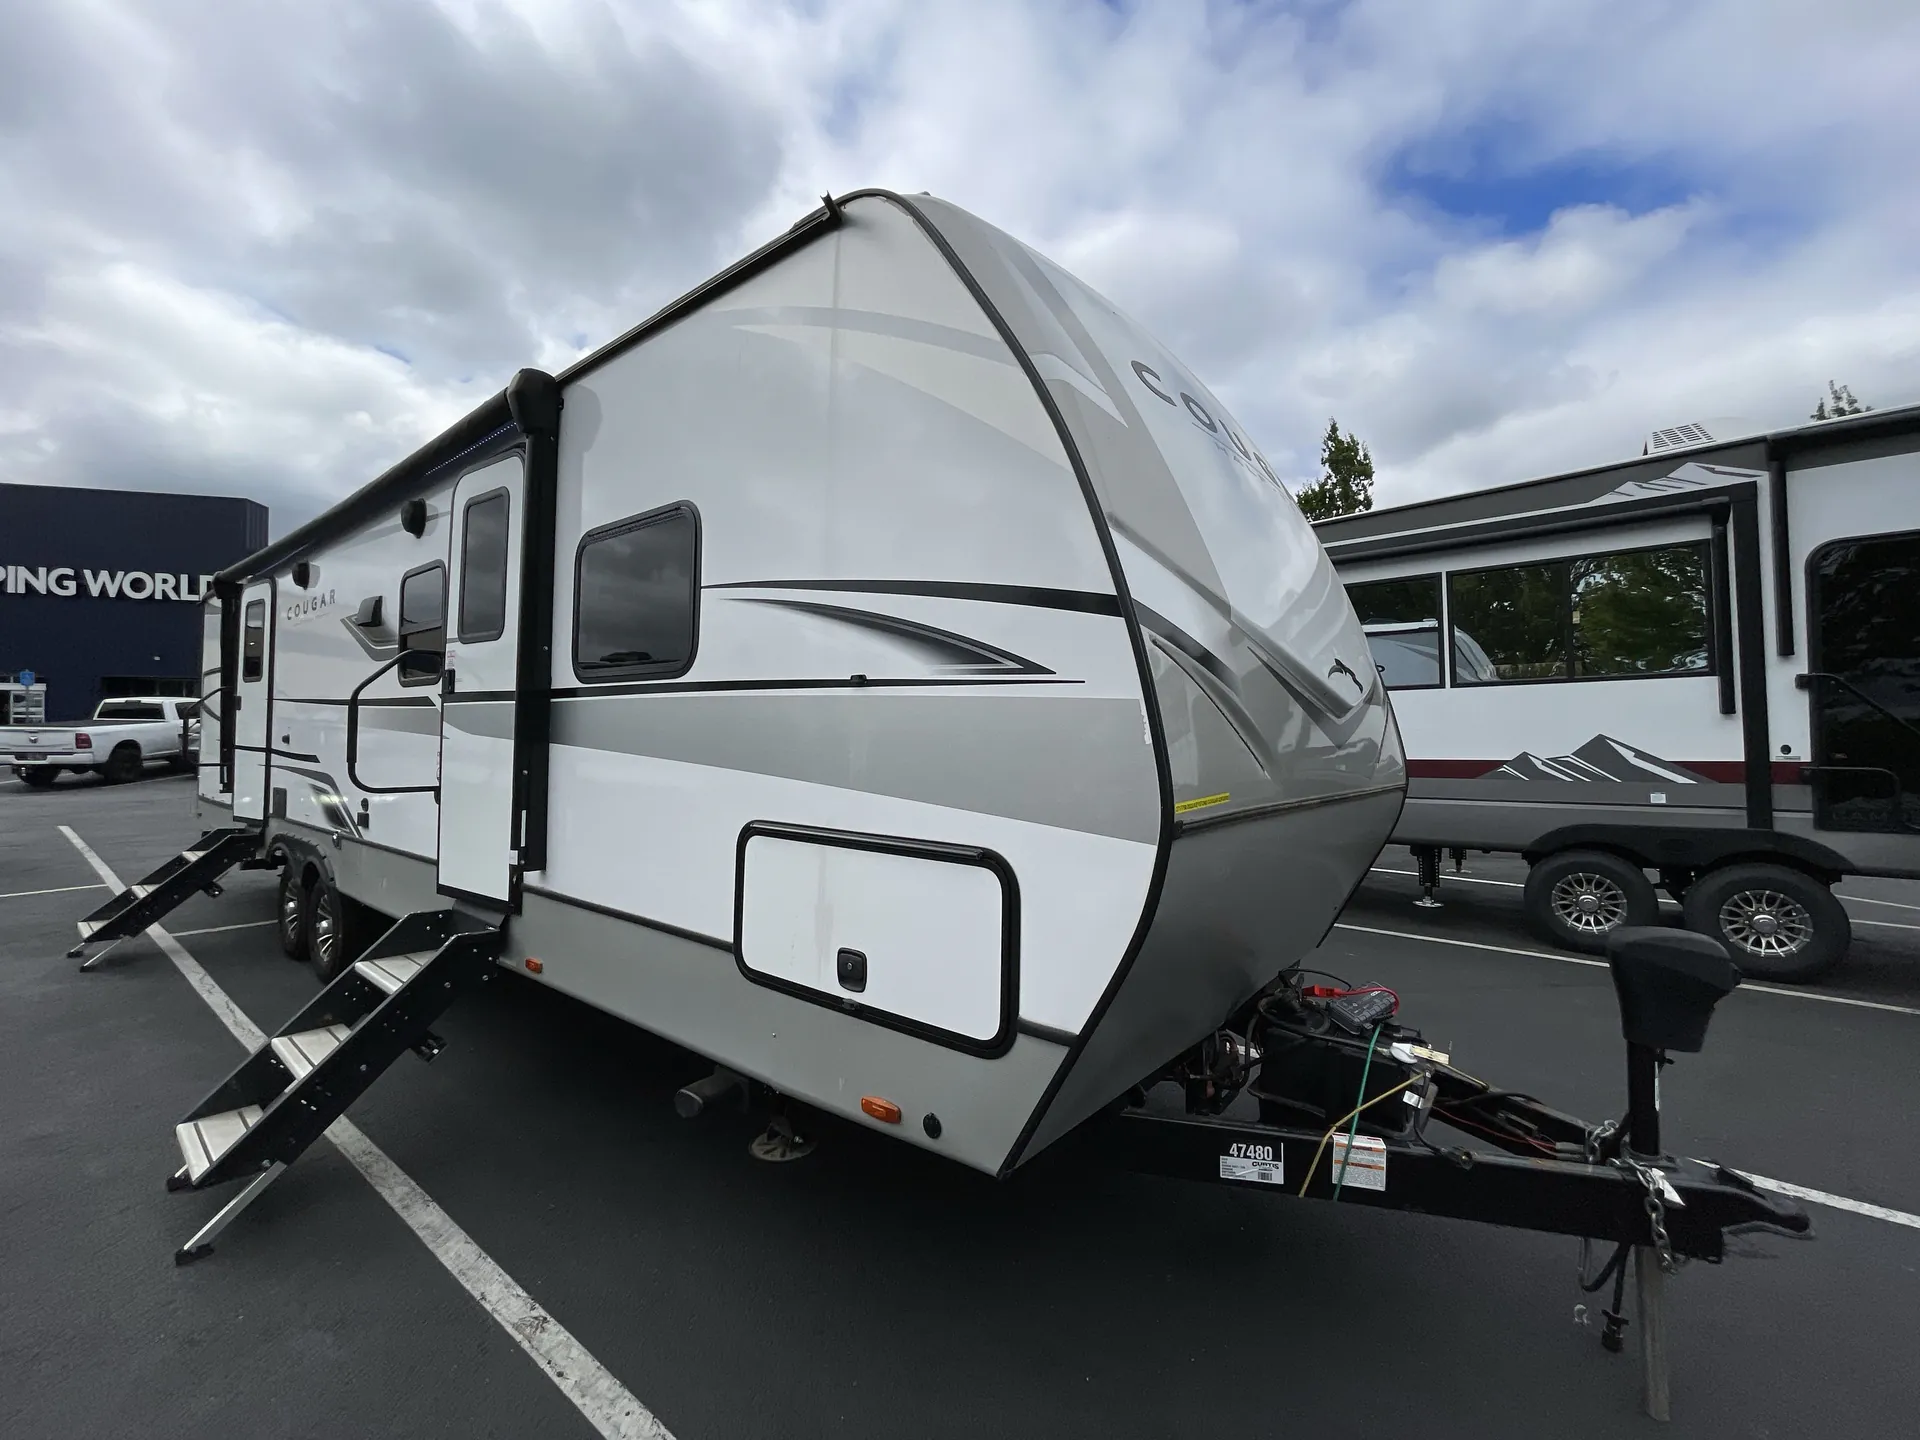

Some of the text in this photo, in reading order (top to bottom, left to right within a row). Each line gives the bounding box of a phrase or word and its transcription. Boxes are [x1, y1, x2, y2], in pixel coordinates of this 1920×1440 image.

[287, 588, 336, 621] COUGAR
[1229, 1143, 1273, 1161] 47480
[1251, 1161, 1280, 1170] CURTIS
